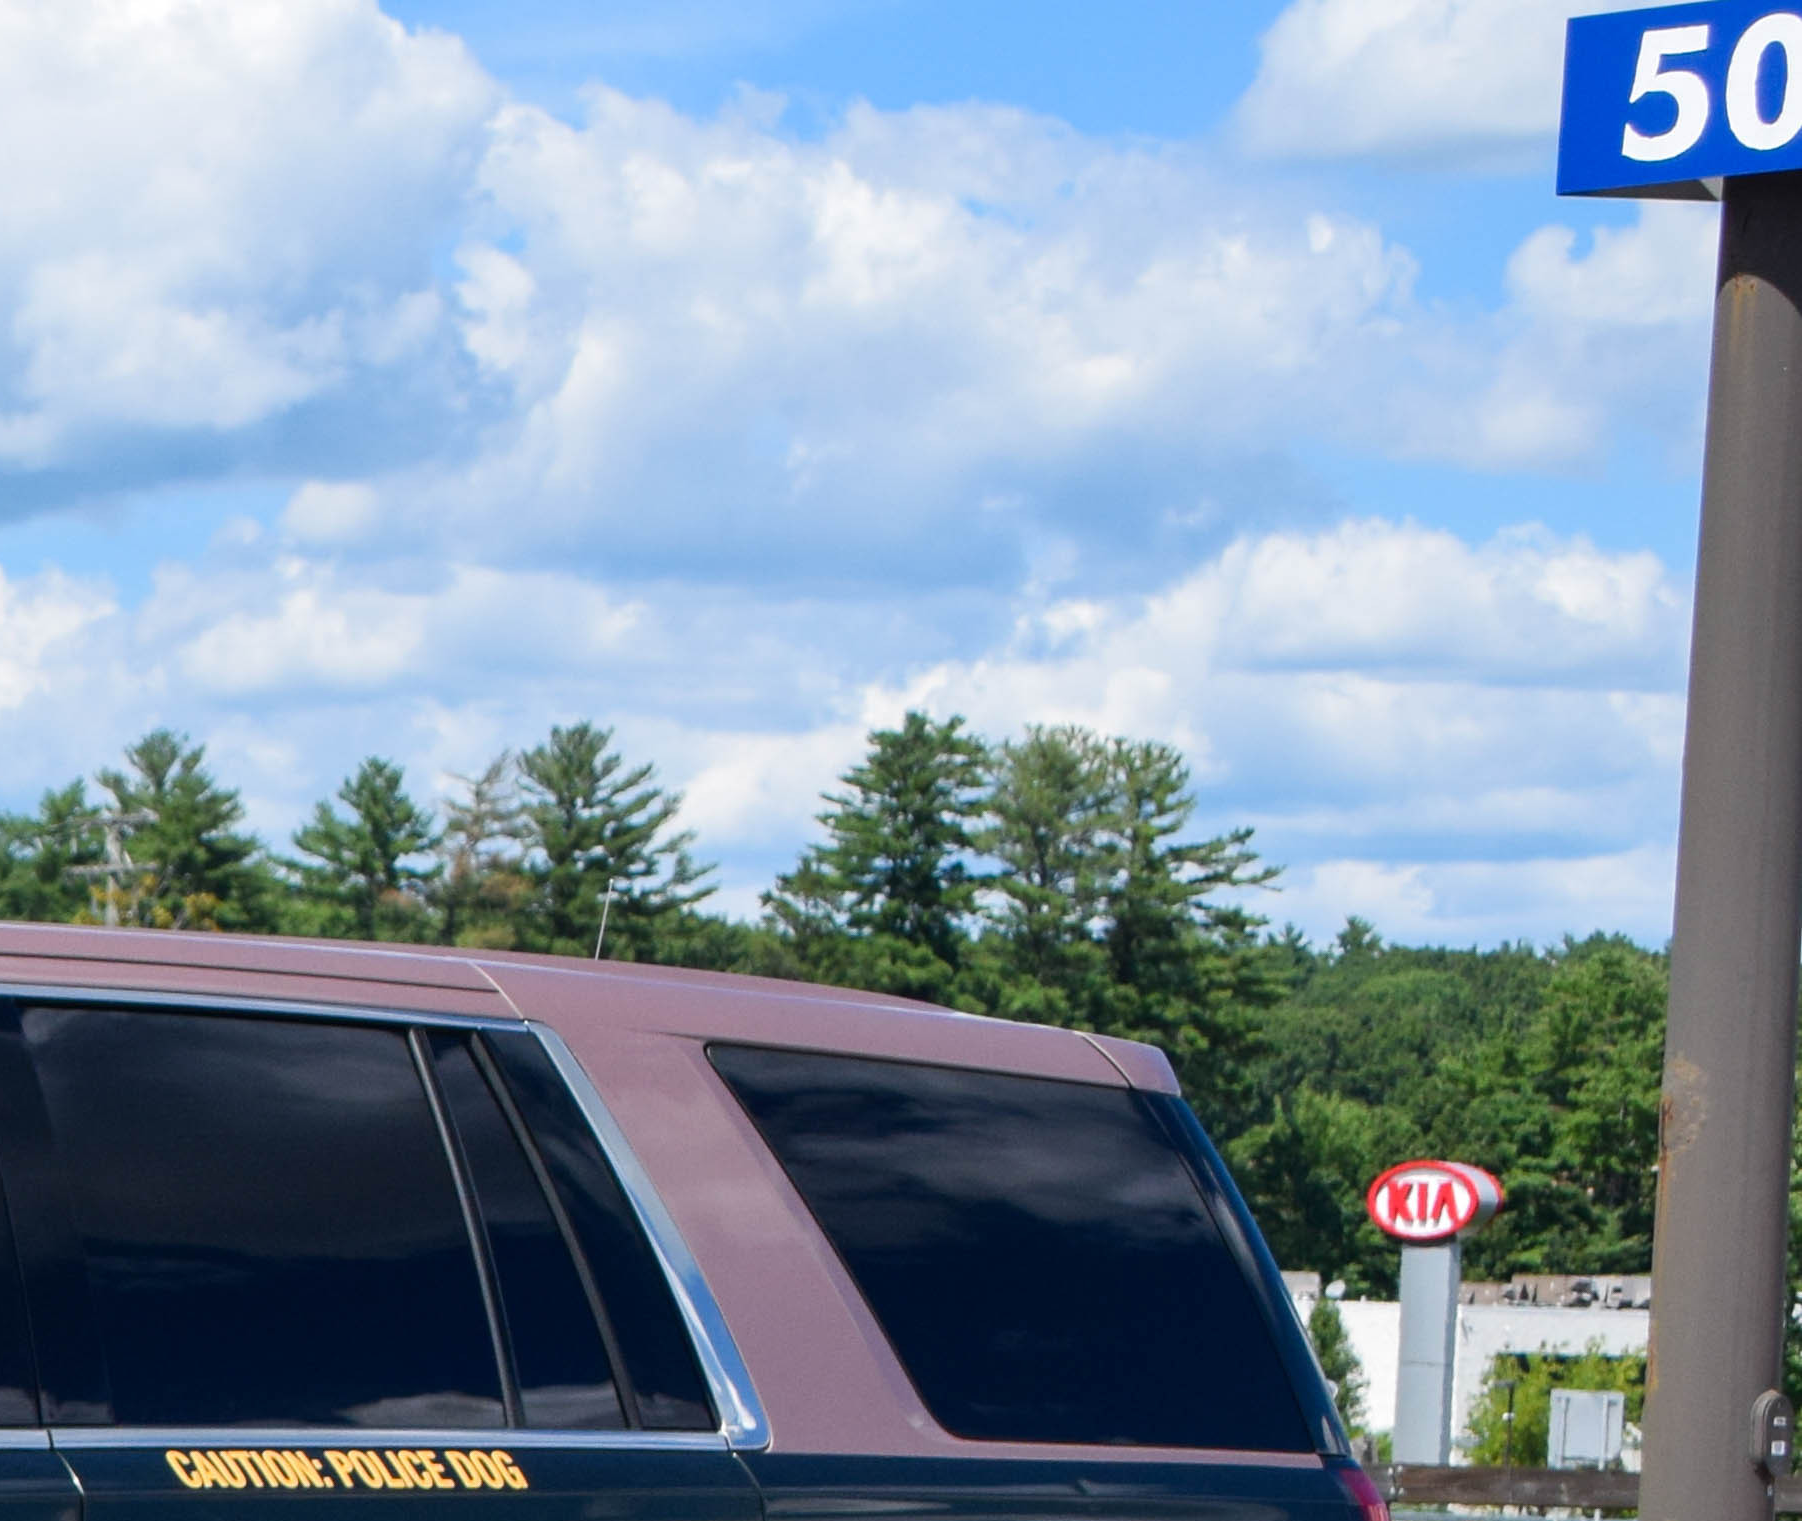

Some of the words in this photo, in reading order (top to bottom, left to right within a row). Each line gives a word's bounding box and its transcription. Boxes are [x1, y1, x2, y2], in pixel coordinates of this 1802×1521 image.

[1621, 12, 1802, 162] 50
[1388, 1181, 1459, 1224] KIA
[164, 1449, 335, 1489] CAUTION:
[323, 1449, 455, 1490] POLICE
[443, 1449, 529, 1490] DOG
